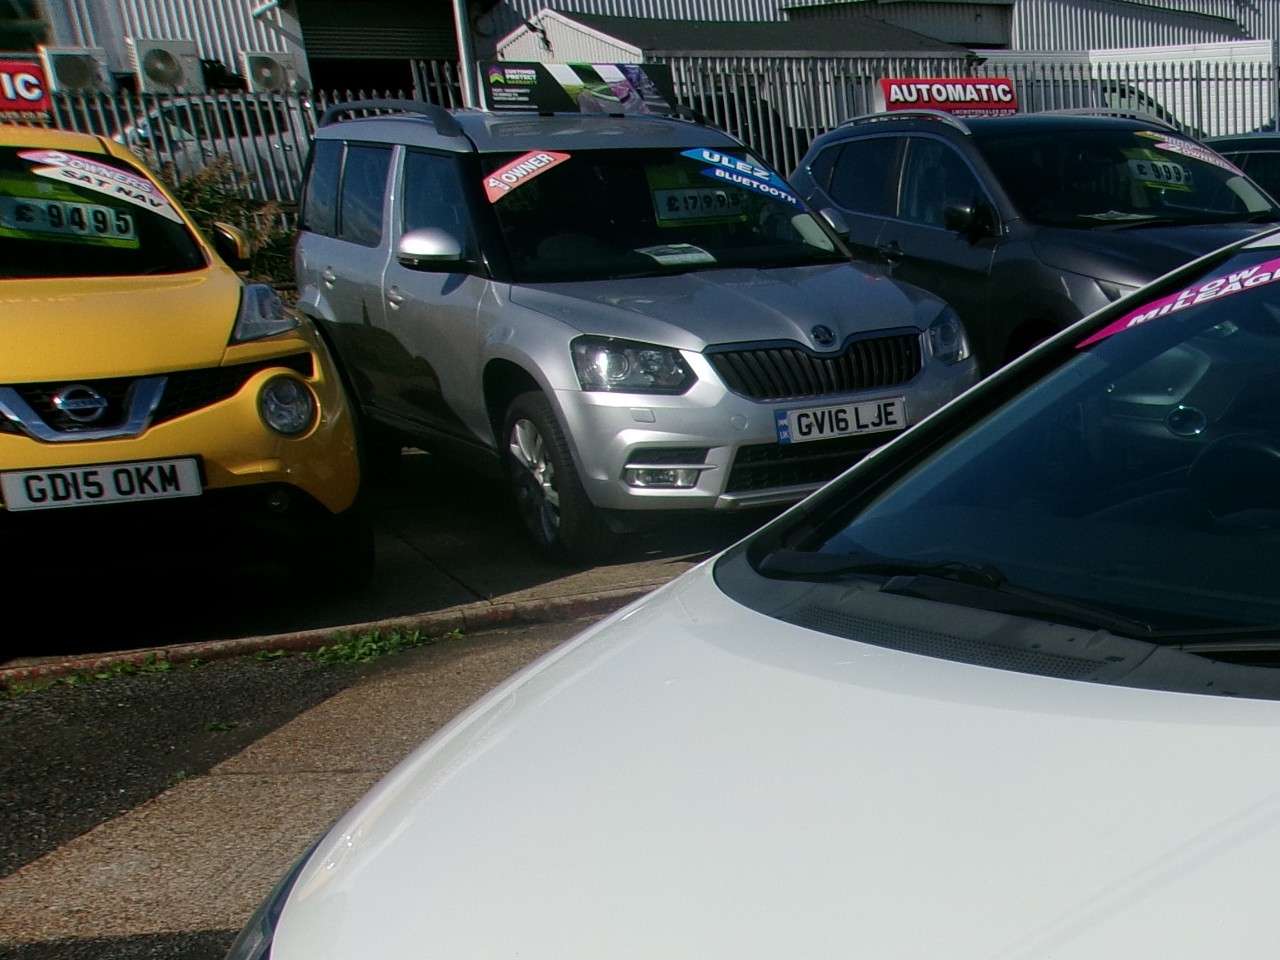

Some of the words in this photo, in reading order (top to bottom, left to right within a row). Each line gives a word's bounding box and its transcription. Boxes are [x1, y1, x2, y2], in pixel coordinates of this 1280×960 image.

[889, 84, 1012, 102] AUTOMATIC
[46, 150, 69, 166] 2
[69, 159, 152, 193] OWNERS
[501, 153, 555, 184] OWNER
[702, 151, 771, 181] ULEZ
[61, 169, 110, 187] SAT
[116, 186, 164, 208] NAV
[715, 168, 797, 204] BLUETOOTH
[1175, 265, 1264, 301] LOW
[797, 408, 850, 436] GV16
[854, 402, 898, 430] LJE
[24, 470, 104, 503] GD15
[113, 464, 181, 496] OKM
